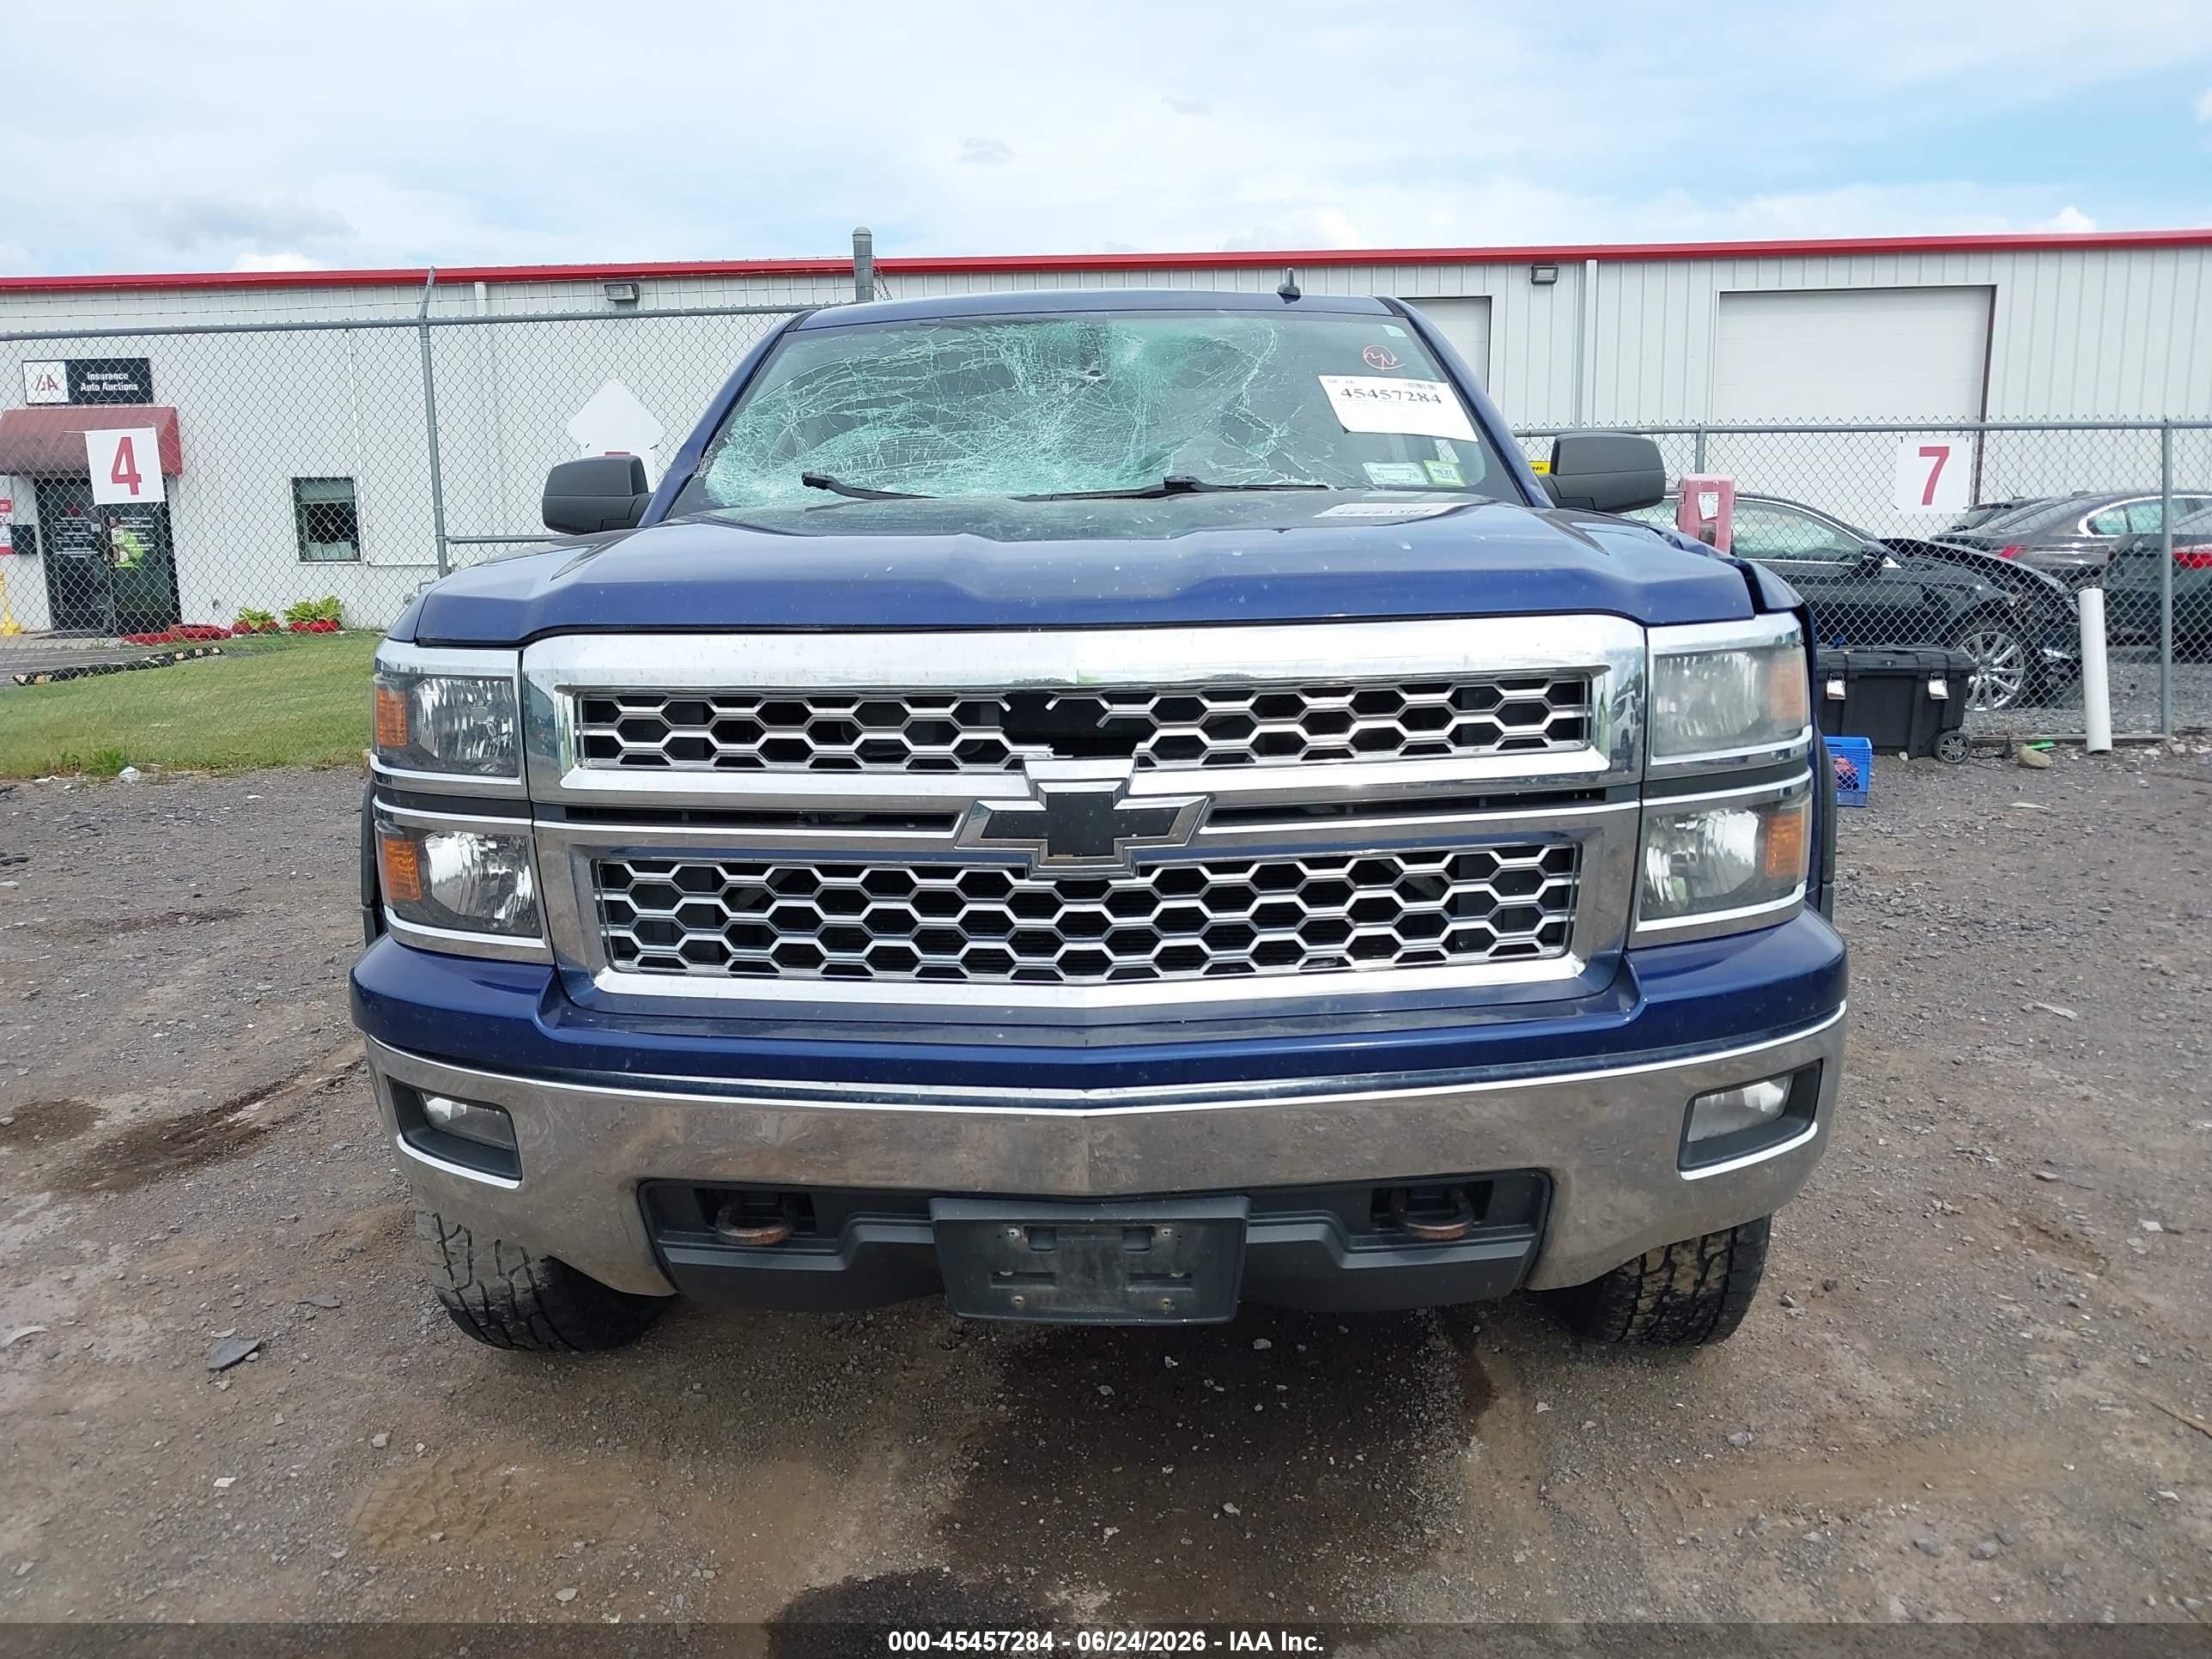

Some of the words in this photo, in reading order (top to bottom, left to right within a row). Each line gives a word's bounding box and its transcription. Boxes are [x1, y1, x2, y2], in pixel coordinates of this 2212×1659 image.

[87, 372, 129, 380] Insurance
[81, 382, 100, 392] Auto
[101, 381, 139, 392] Auctions
[1340, 387, 1443, 404] 45457284
[111, 436, 143, 495] 4
[1918, 446, 1950, 506] 7
